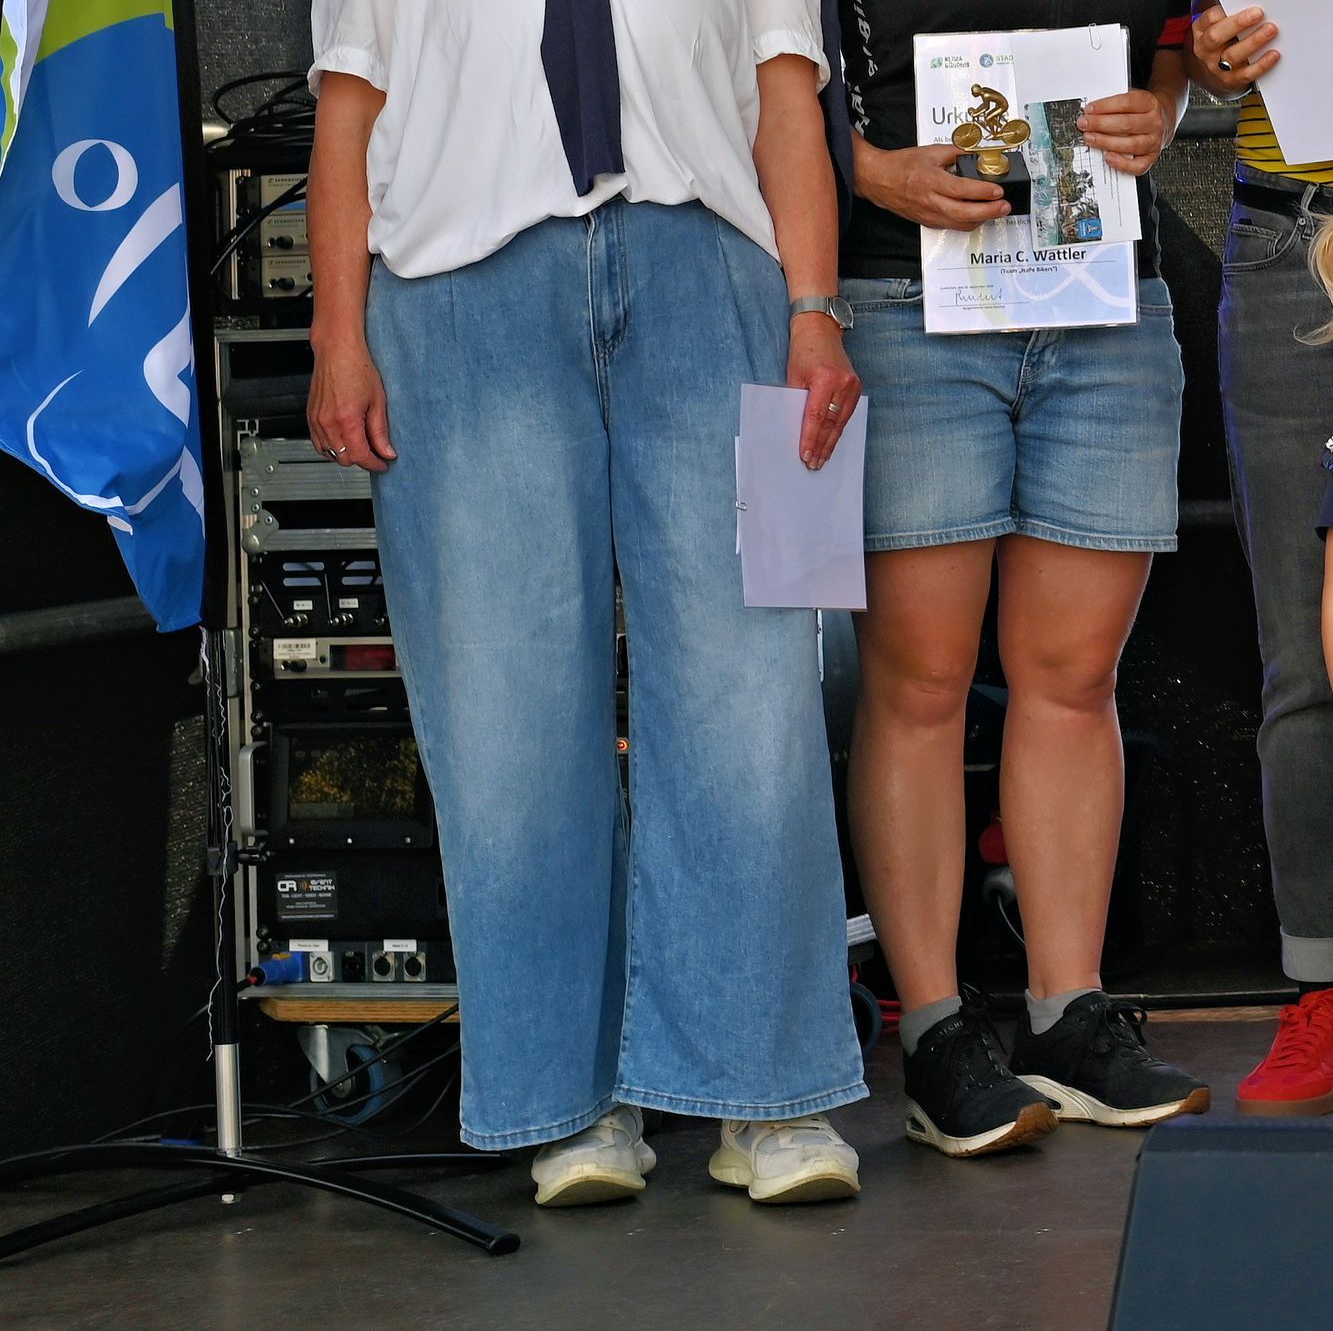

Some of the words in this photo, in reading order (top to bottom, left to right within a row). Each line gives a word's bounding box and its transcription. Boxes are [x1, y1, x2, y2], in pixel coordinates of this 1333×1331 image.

[970, 251, 1012, 265] Maria
[1016, 250, 1028, 262] C.
[1033, 247, 1087, 262] Wattler
